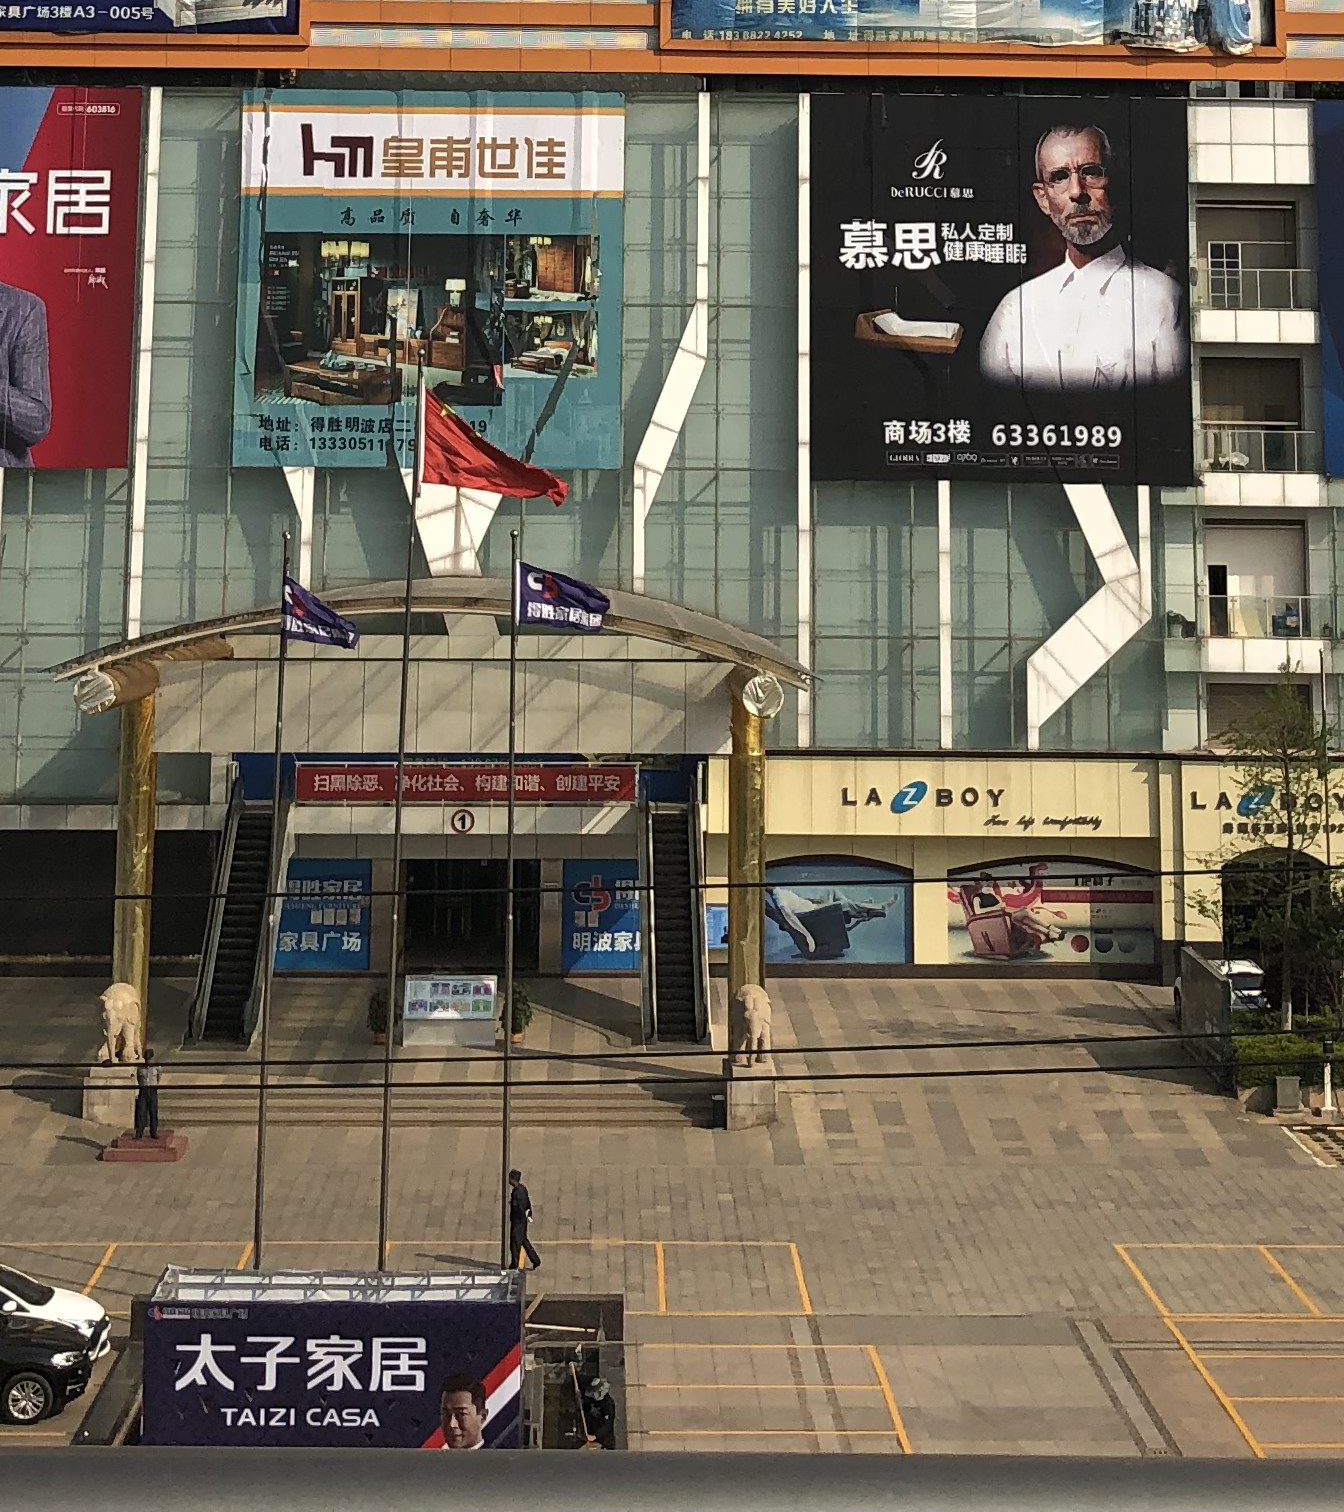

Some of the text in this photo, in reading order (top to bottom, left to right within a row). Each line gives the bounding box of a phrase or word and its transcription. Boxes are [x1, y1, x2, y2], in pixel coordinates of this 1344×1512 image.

[380, 135, 567, 180] 皇甫世佳
[339, 207, 417, 226] 高品质
[941, 222, 1014, 241] 私人定制
[838, 218, 942, 271] 慕思
[943, 241, 1028, 265] 健康睡眠
[882, 419, 1123, 448] 商场3楼 63361989
[279, 931, 362, 952] 家具广场
[174, 1333, 429, 1392] 太子家居
[221, 1407, 381, 1427] TAIZI CASA
